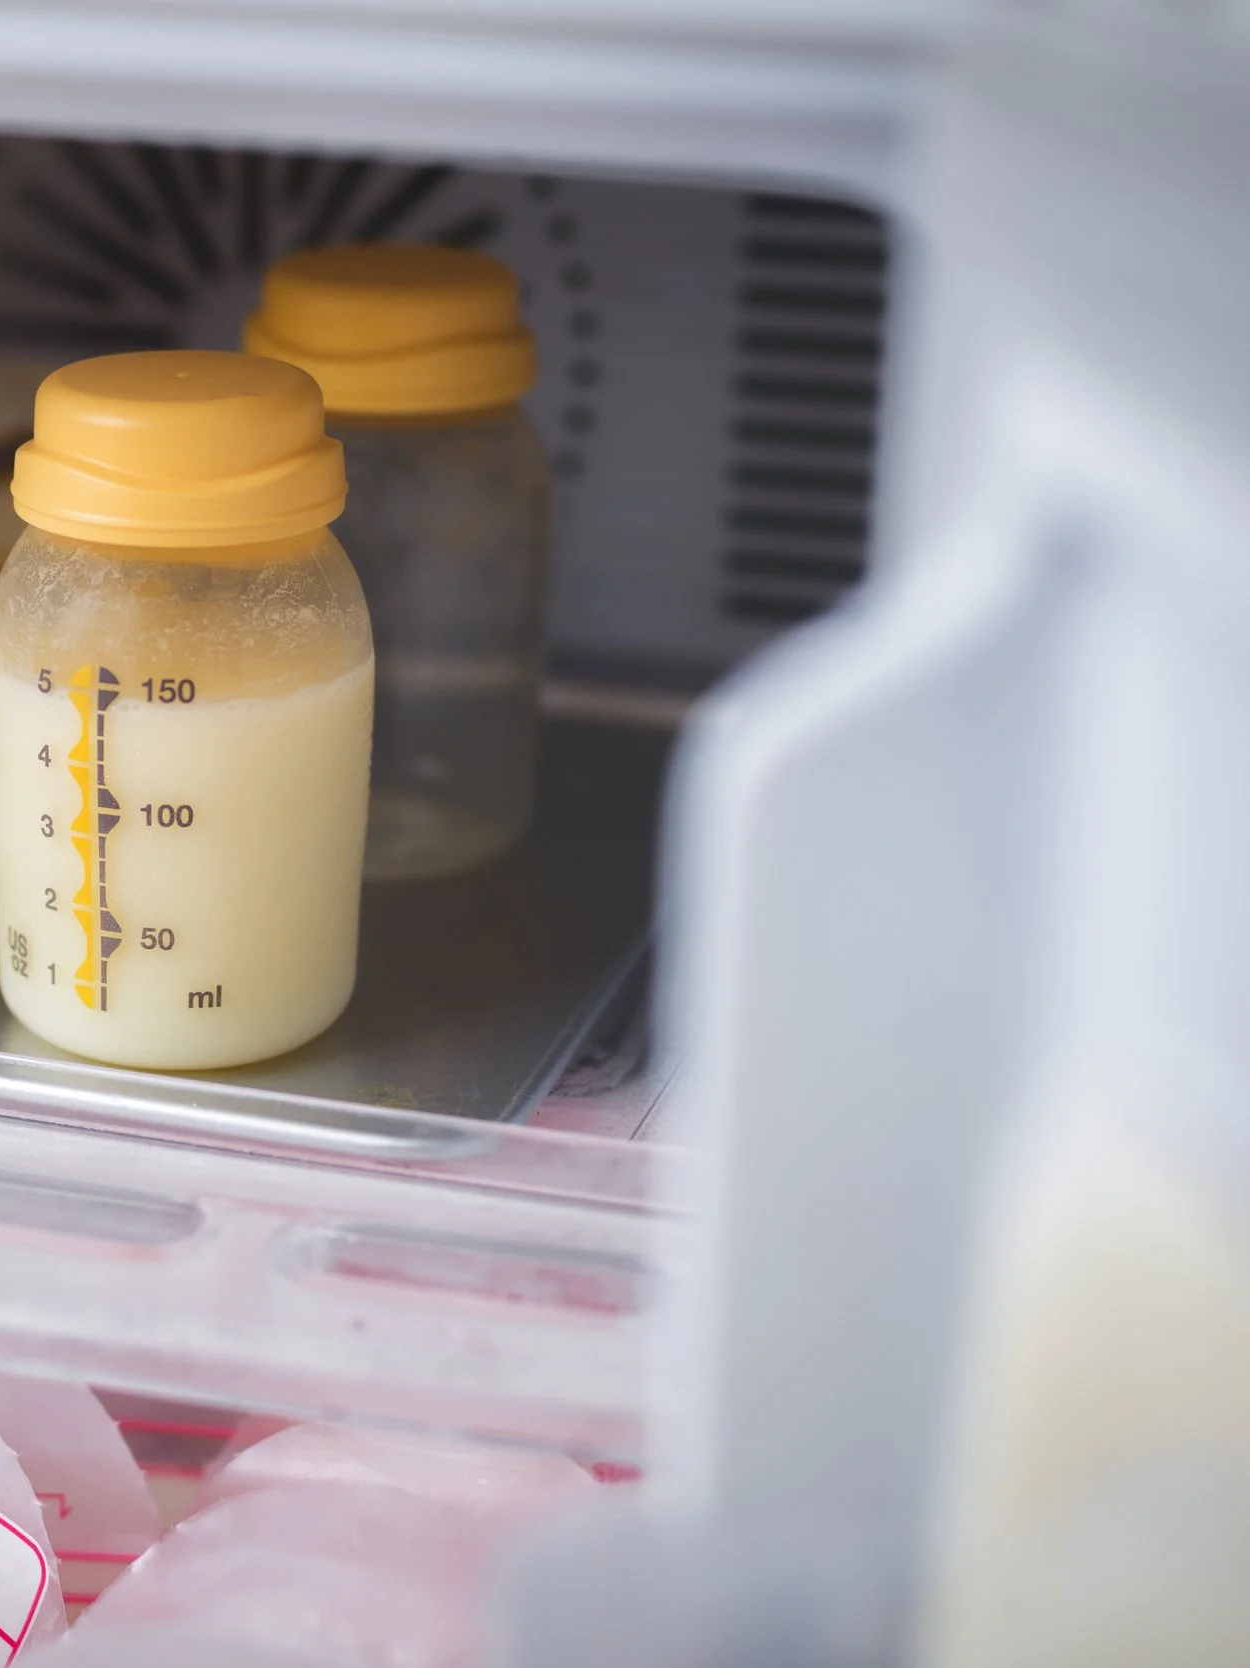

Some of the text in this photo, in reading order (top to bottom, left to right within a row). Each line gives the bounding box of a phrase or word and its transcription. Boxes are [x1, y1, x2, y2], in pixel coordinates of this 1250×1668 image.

[37, 667, 53, 694] 5
[141, 677, 196, 704] 150
[37, 744, 52, 768] 4
[40, 813, 55, 838] 3
[140, 803, 194, 828] 100
[44, 887, 58, 911] 2
[7, 925, 28, 958] US
[140, 927, 176, 951] 50
[47, 962, 56, 985] 1
[188, 984, 222, 1009] ml
